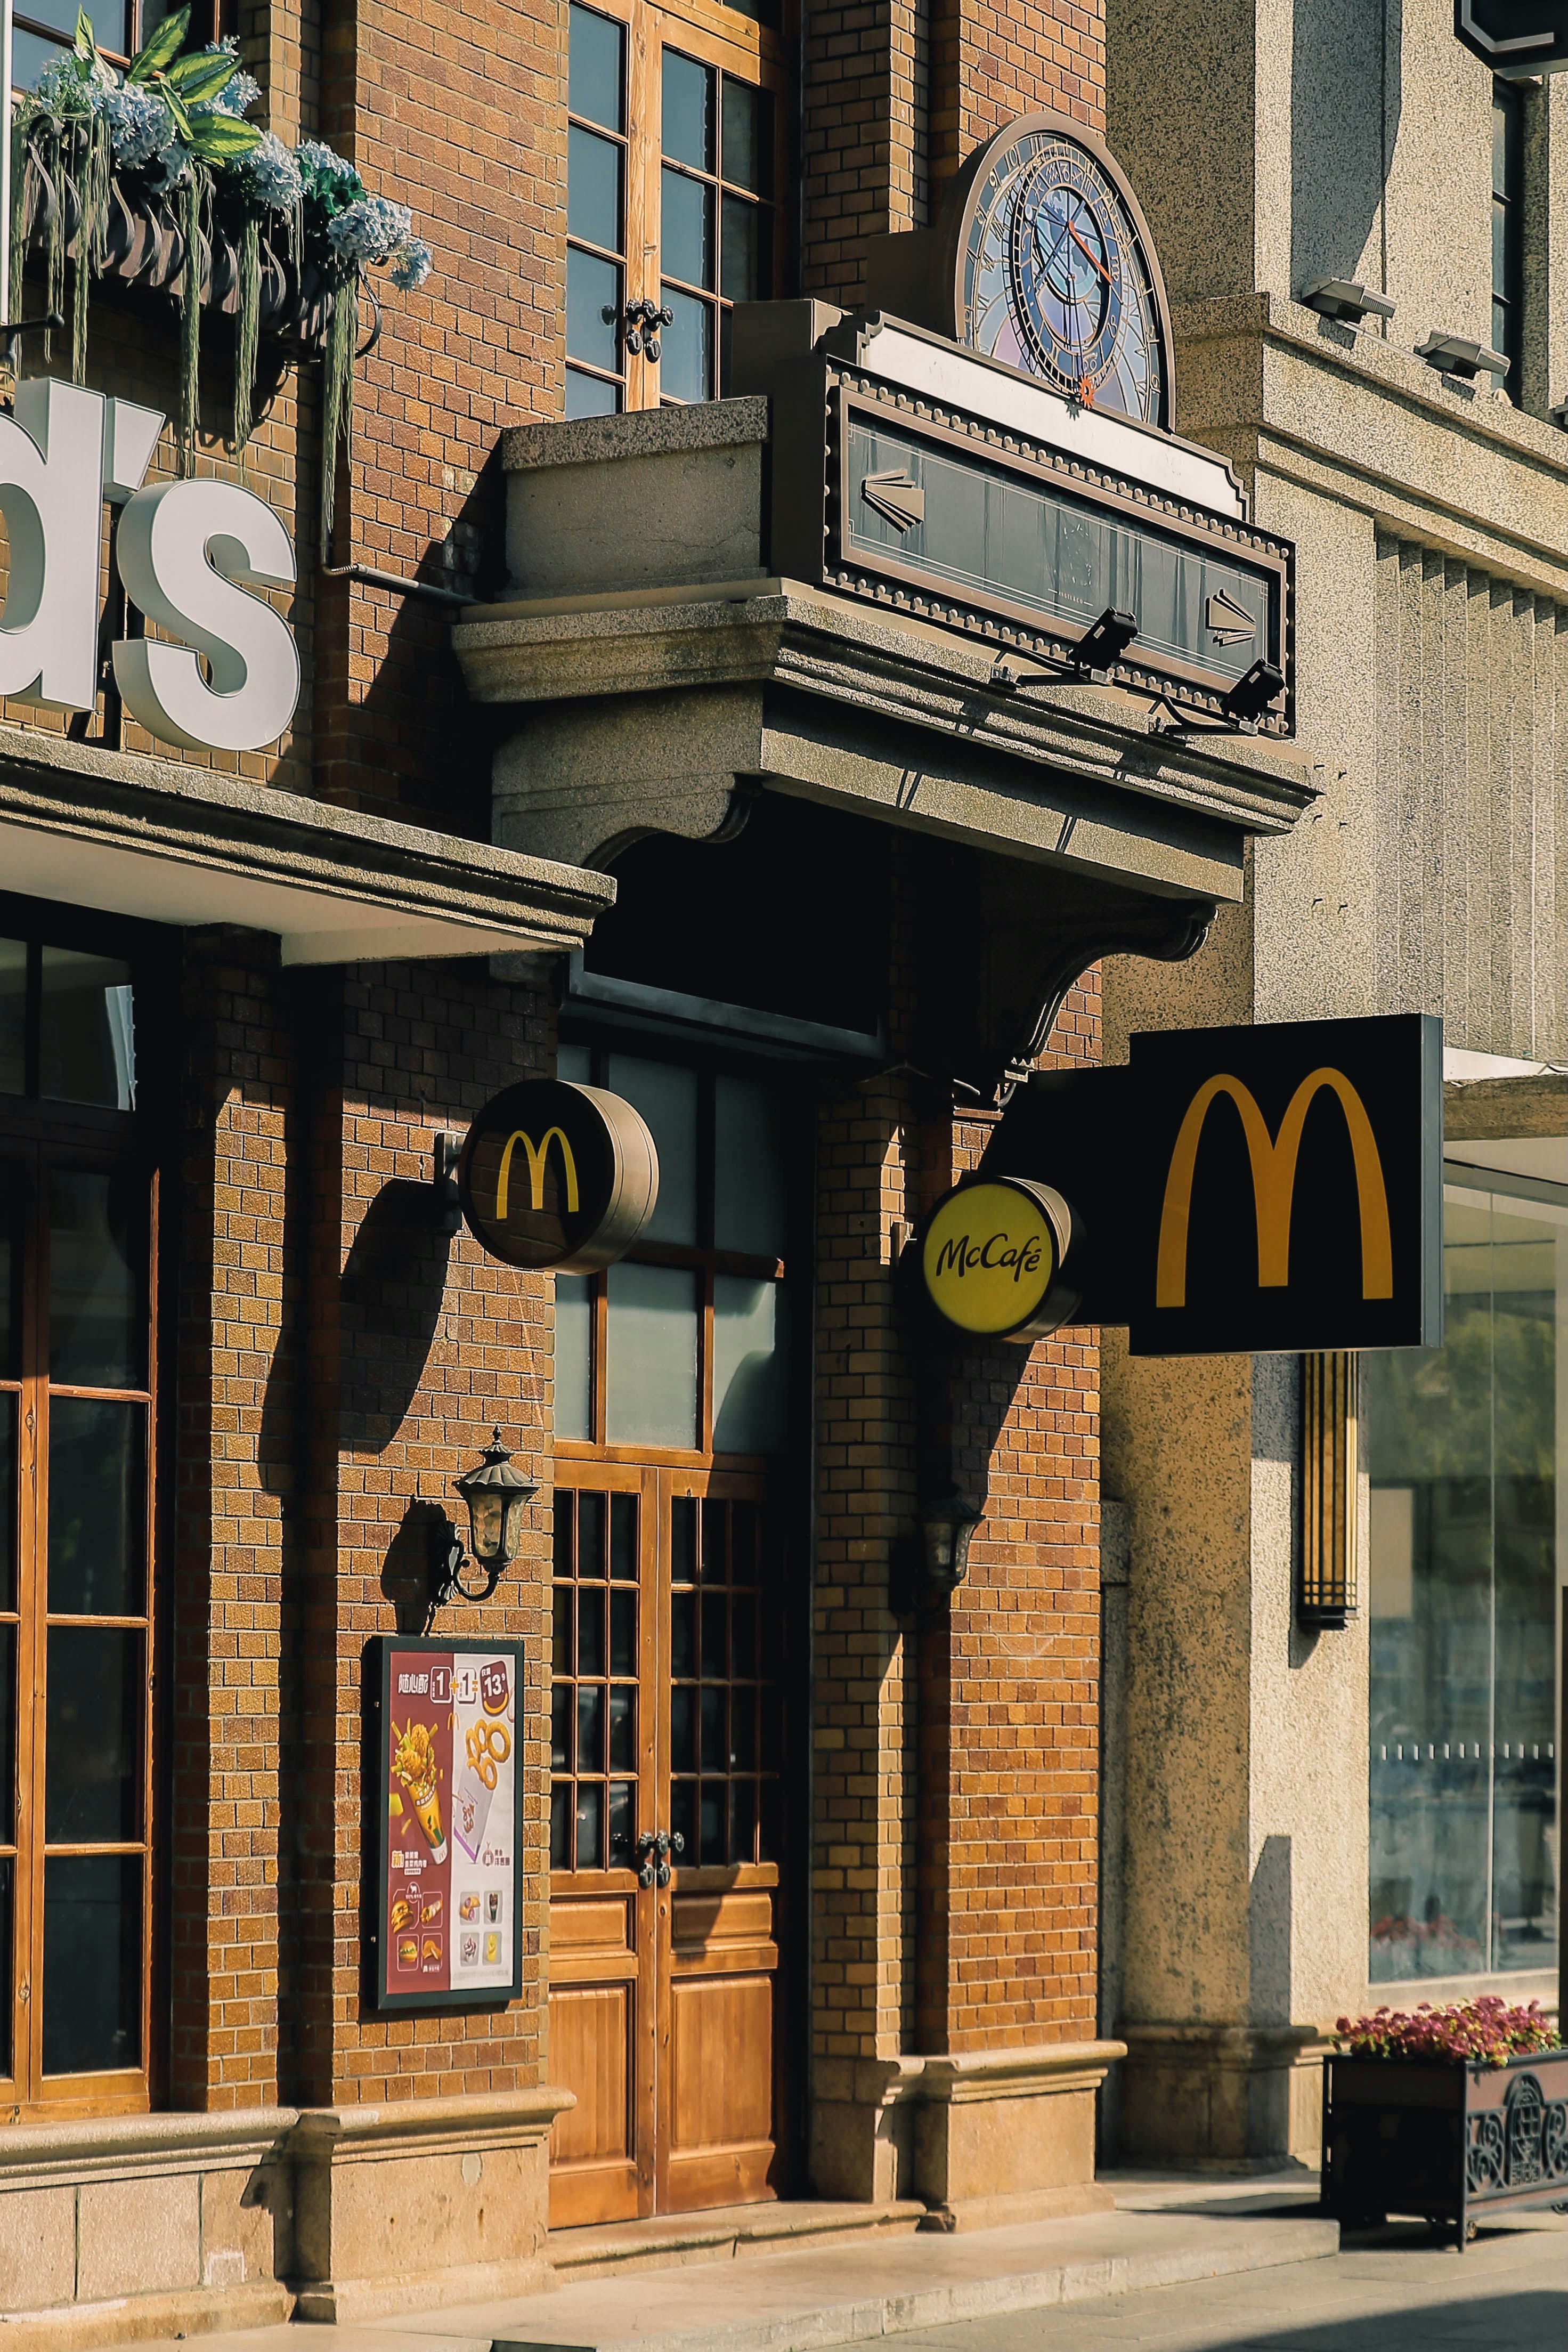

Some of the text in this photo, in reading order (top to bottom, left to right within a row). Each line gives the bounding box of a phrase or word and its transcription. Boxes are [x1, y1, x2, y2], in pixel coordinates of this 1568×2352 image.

[1005, 147, 1018, 172] 10
[497, 1127, 579, 1219] M
[1156, 1067, 1393, 1308] M
[936, 1233, 1042, 1282] McCafé
